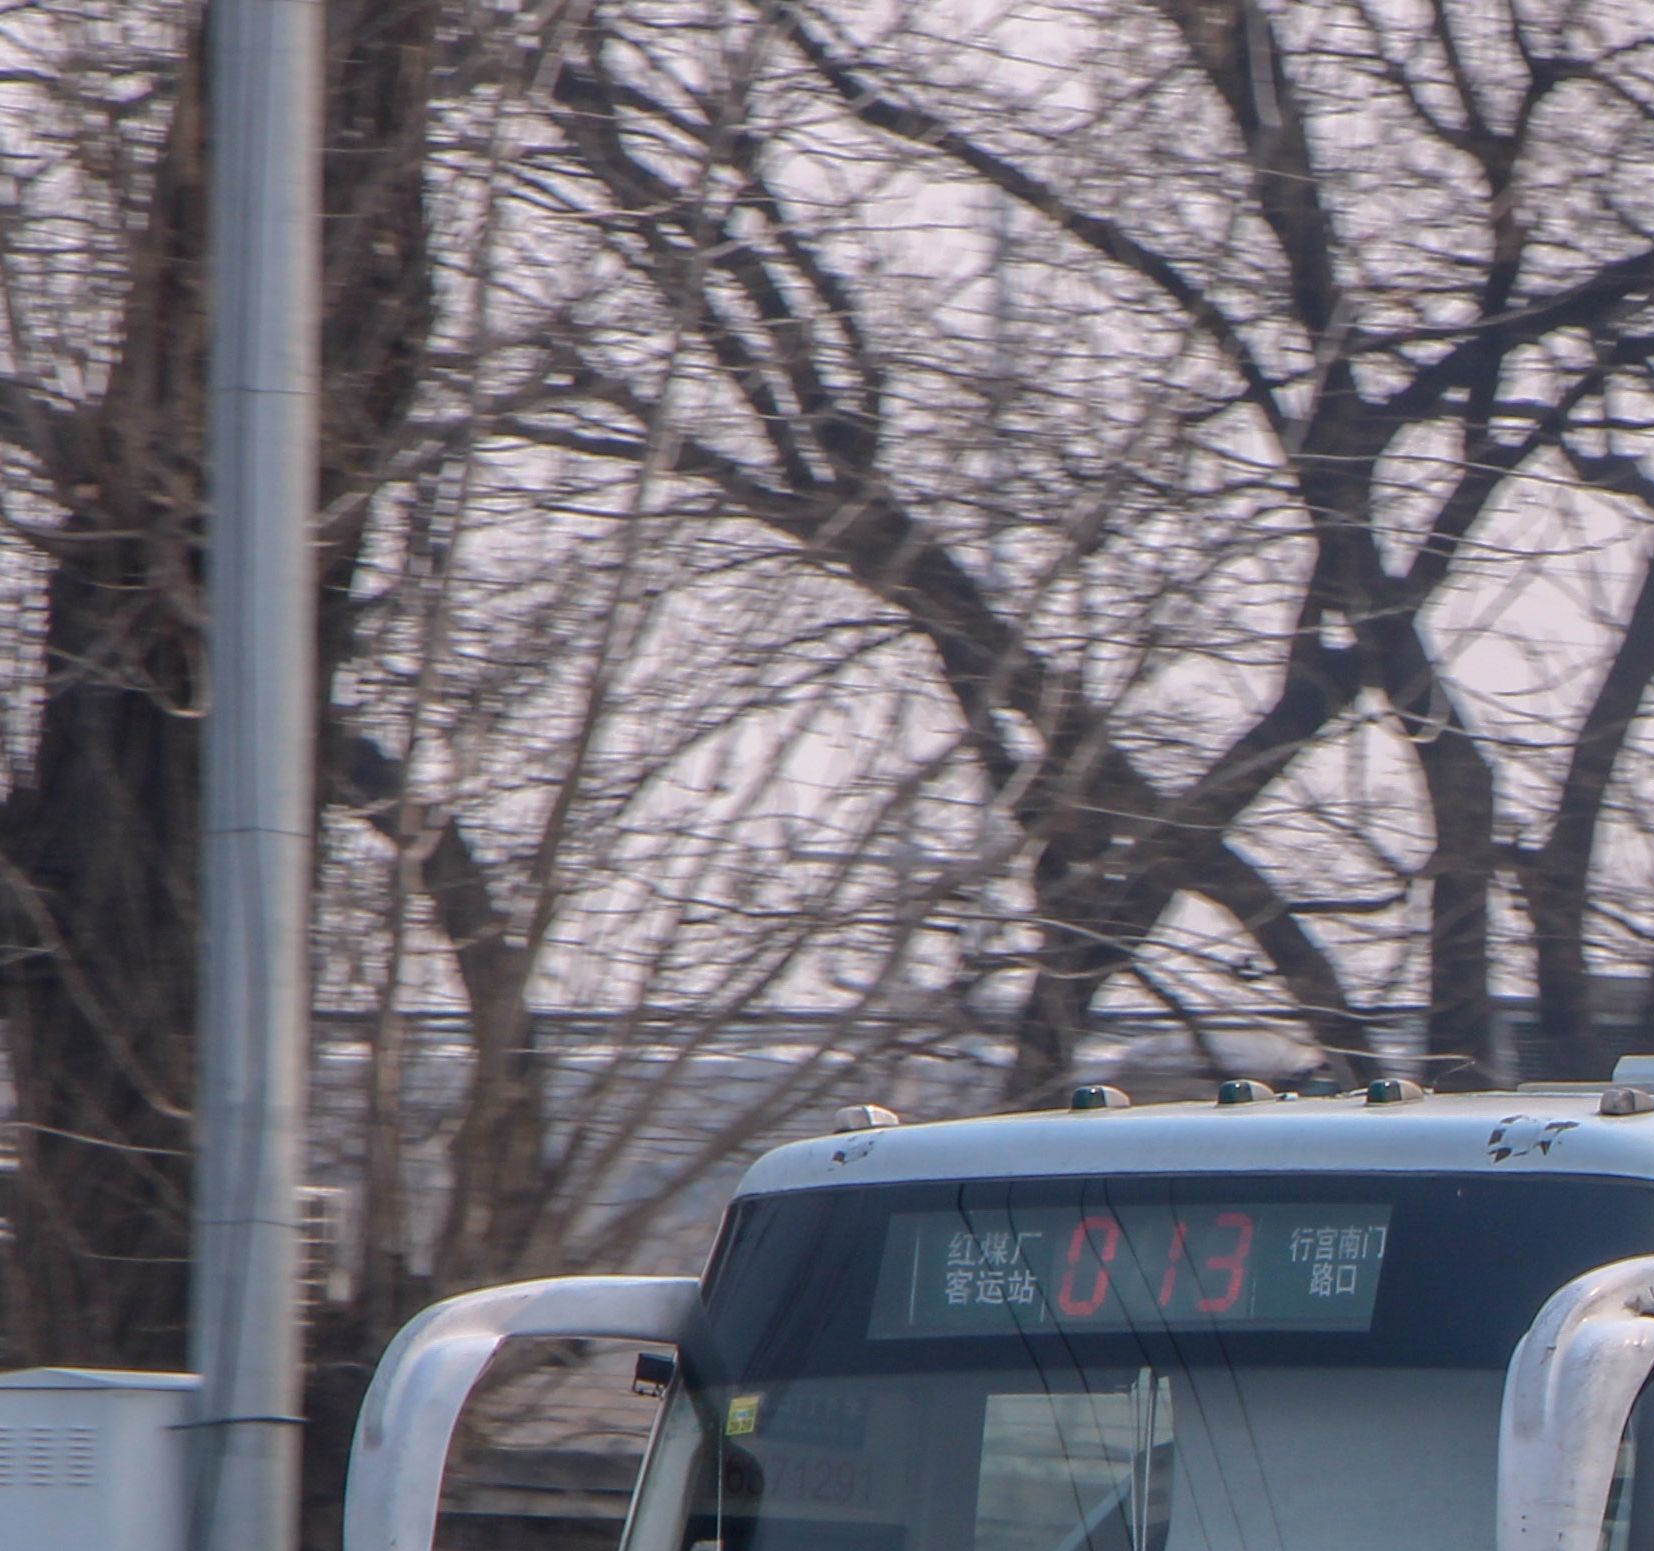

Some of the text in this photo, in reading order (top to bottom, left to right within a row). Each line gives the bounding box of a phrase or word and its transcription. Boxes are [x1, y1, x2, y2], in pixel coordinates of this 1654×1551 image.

[947, 1231, 1042, 1266] 红煤厂
[1289, 1226, 1388, 1262] 行宫南门
[1059, 1212, 1253, 1316] 013
[1309, 1263, 1357, 1296] 路口
[945, 1269, 1037, 1305] 客运站
